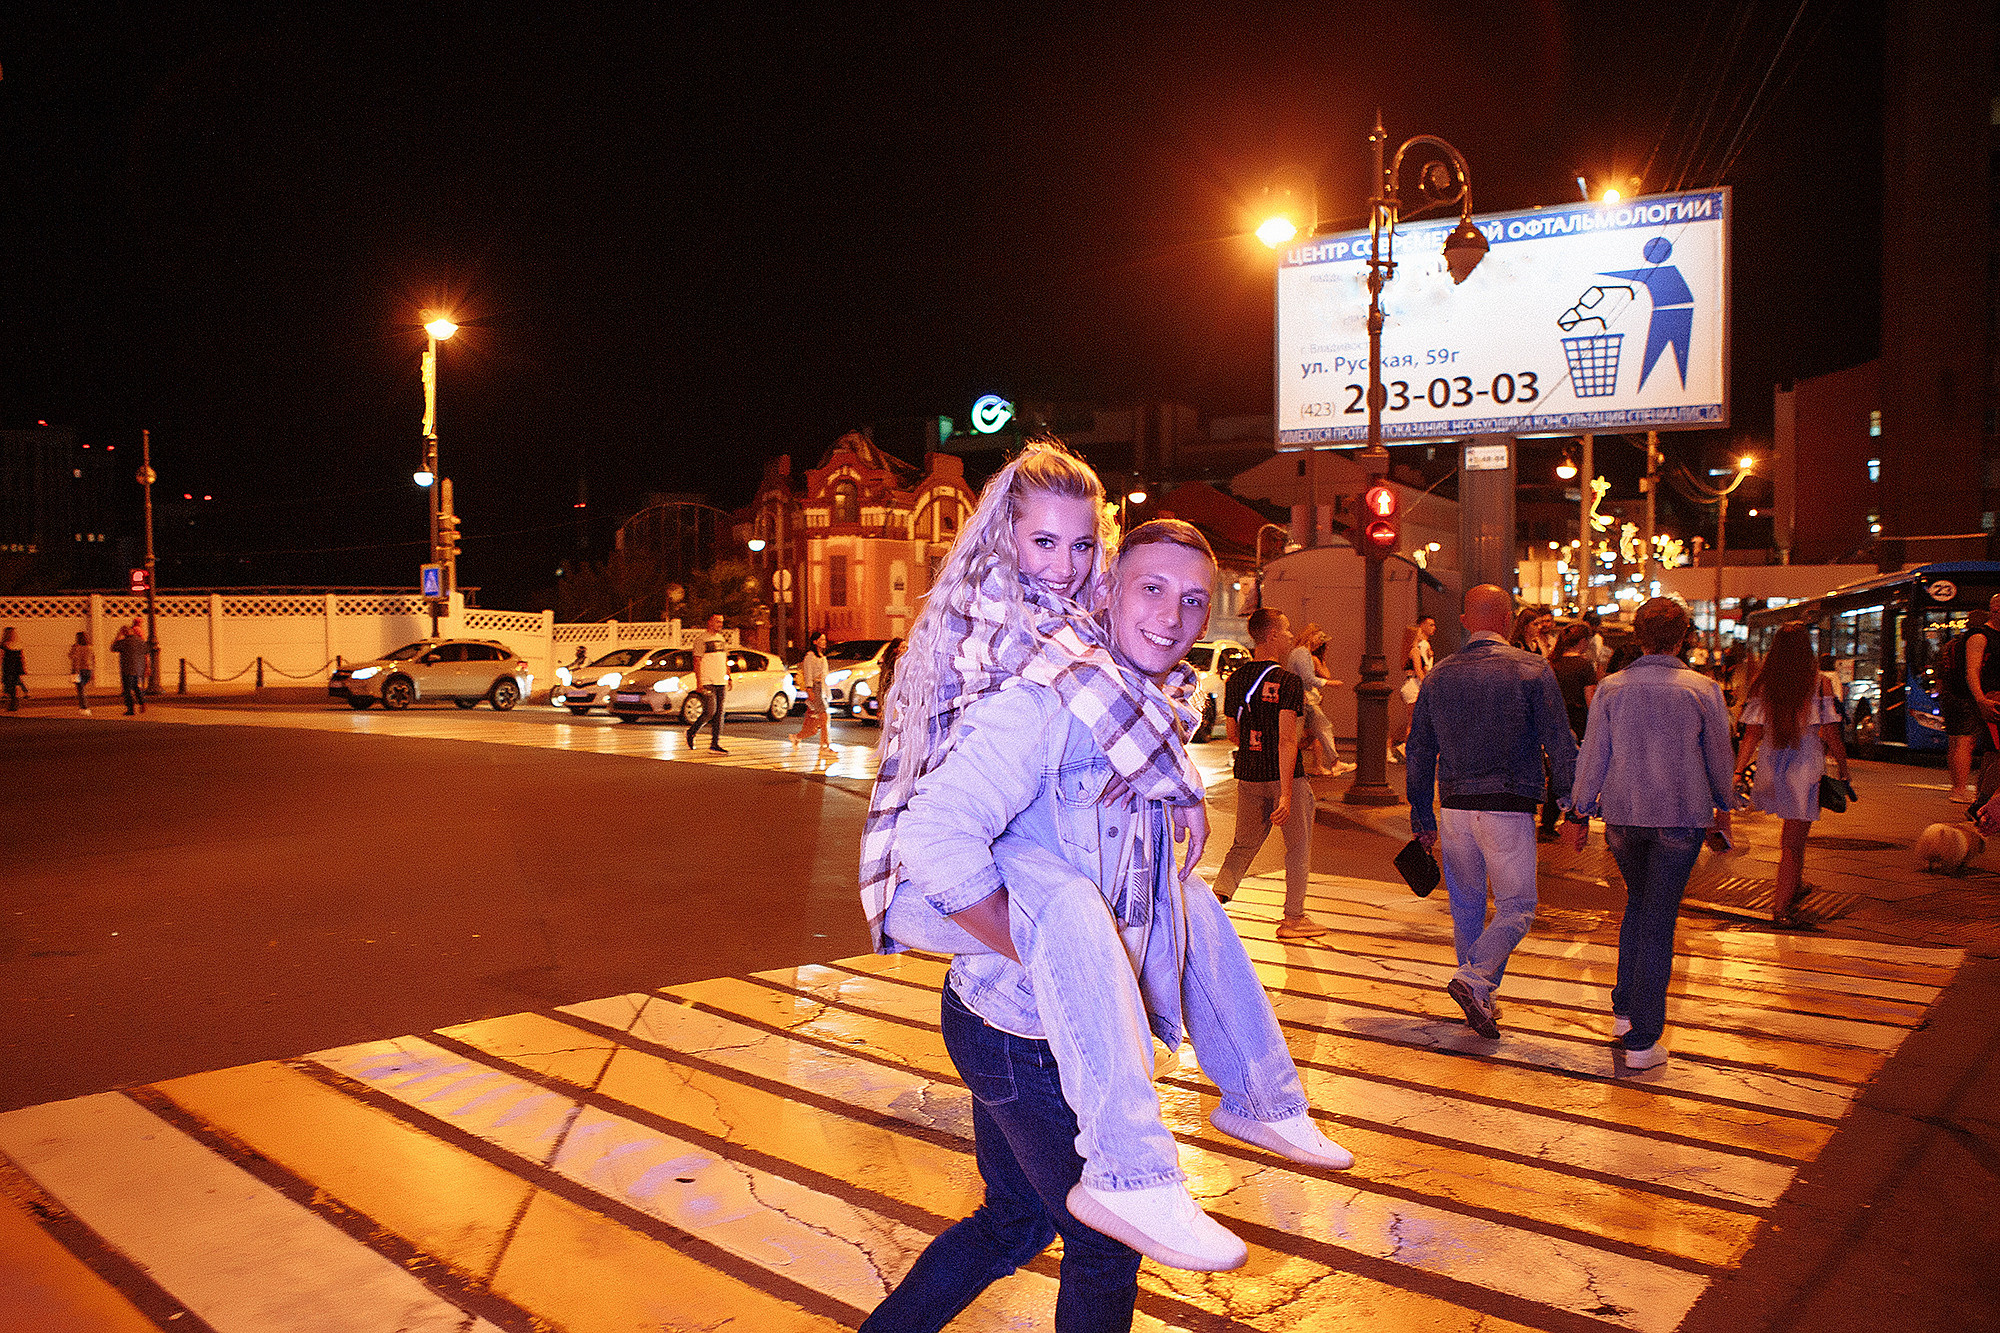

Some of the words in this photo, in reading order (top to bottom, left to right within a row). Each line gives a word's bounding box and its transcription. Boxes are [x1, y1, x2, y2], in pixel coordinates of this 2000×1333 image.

[1288, 241, 1350, 265] ЦЕНТР
[1352, 221, 1504, 258] СОВРЕМЕЙ
[1507, 200, 1713, 239] ОФТАЛЬМОЛОГИИ
[1301, 362, 1328, 379] ул.
[1335, 355, 1418, 376] Руская,
[1426, 348, 1460, 365] 59г
[1300, 401, 1335, 420] (423)
[1343, 371, 1540, 414] 23-03-03
[1934, 584, 1953, 597] 23
